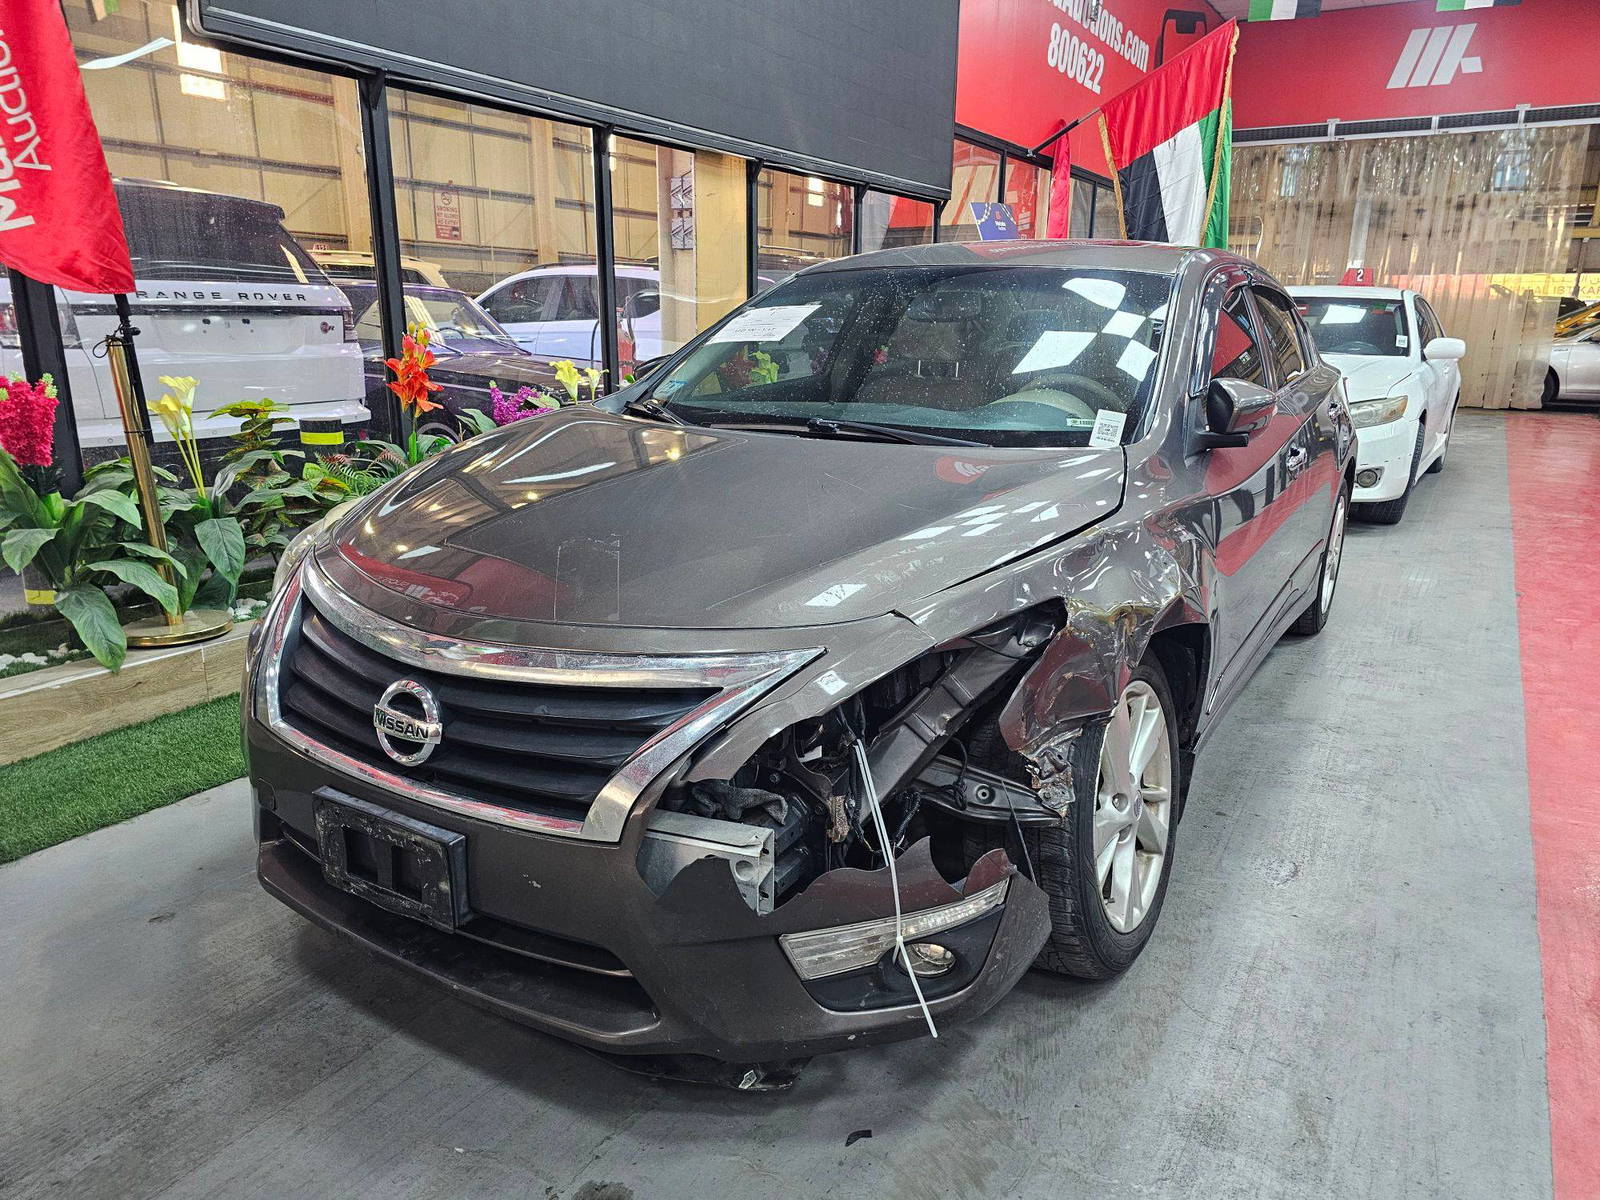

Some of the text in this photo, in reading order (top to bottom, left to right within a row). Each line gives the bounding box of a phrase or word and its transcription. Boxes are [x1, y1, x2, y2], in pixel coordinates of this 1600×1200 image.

[1047, 22, 1104, 95] 800622
[0, 28, 52, 172] Aucti
[1356, 268, 1364, 282] 2
[135, 290, 307, 302] RANGE ROVER
[375, 706, 430, 739] NISSAN
